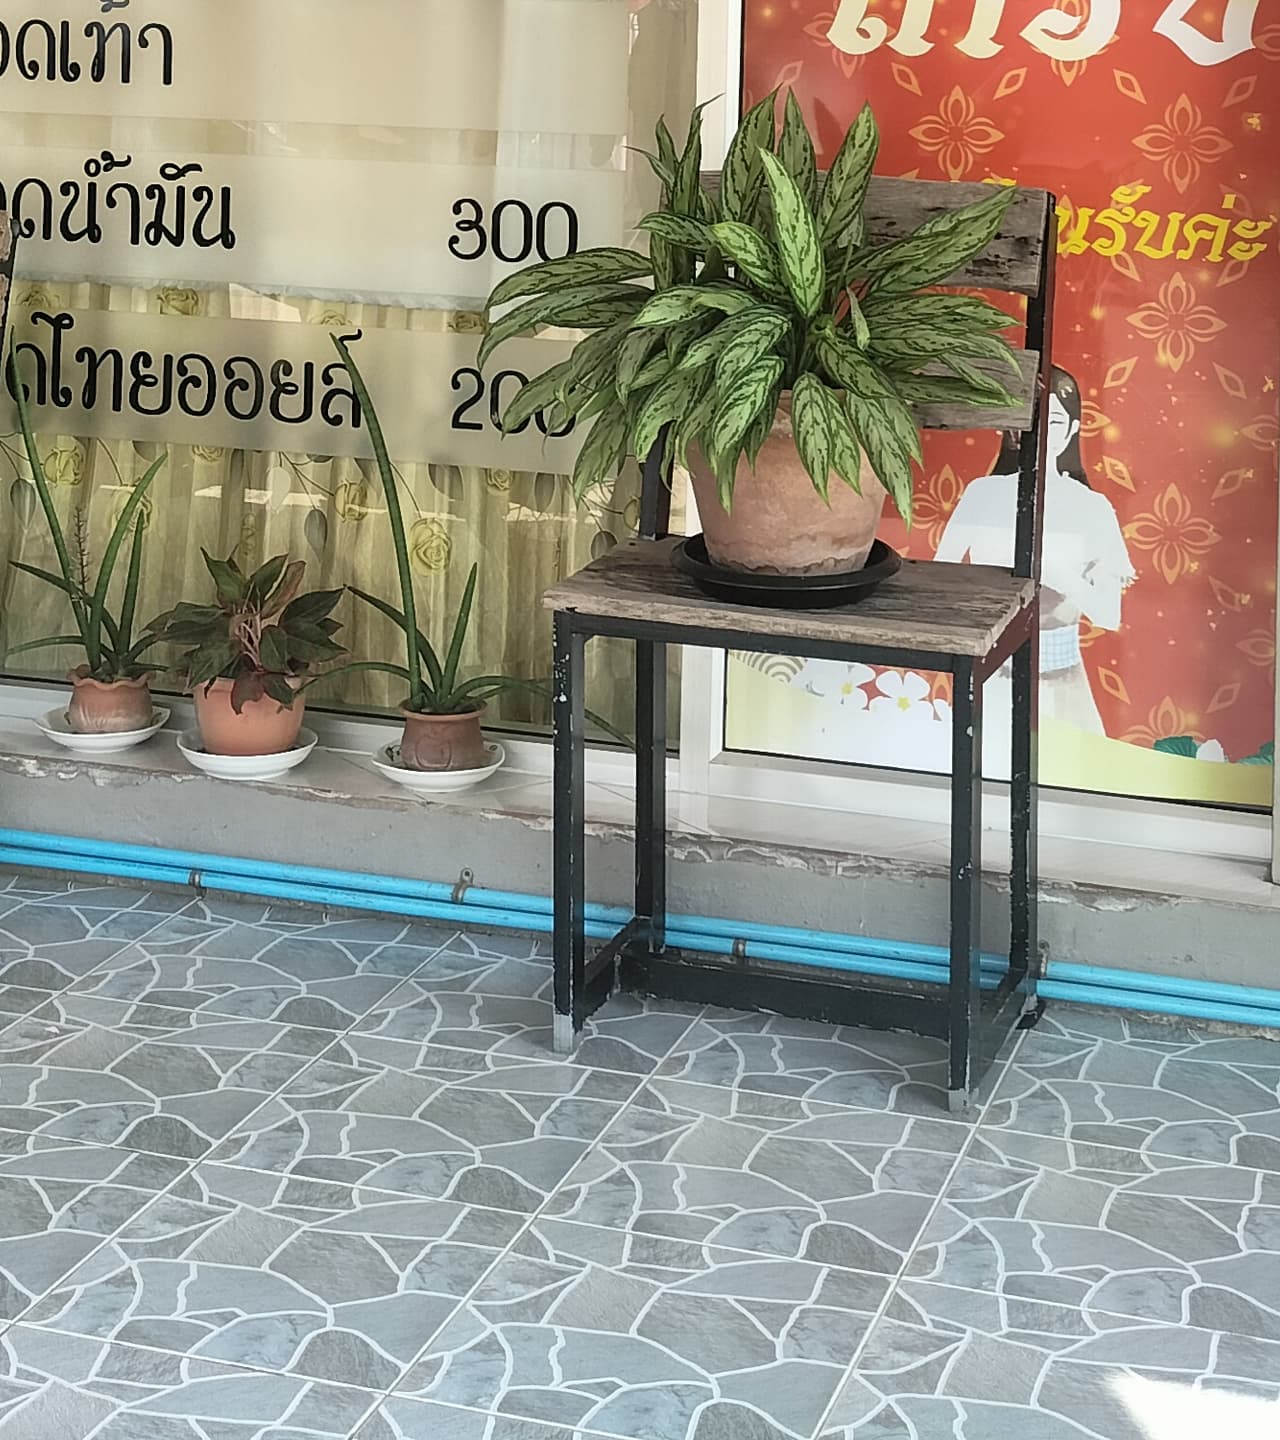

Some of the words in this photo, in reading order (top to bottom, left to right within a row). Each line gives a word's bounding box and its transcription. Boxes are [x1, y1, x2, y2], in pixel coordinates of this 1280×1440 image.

[447, 197, 580, 263] 300
[1054, 177, 1277, 263] นรับค่ะ
